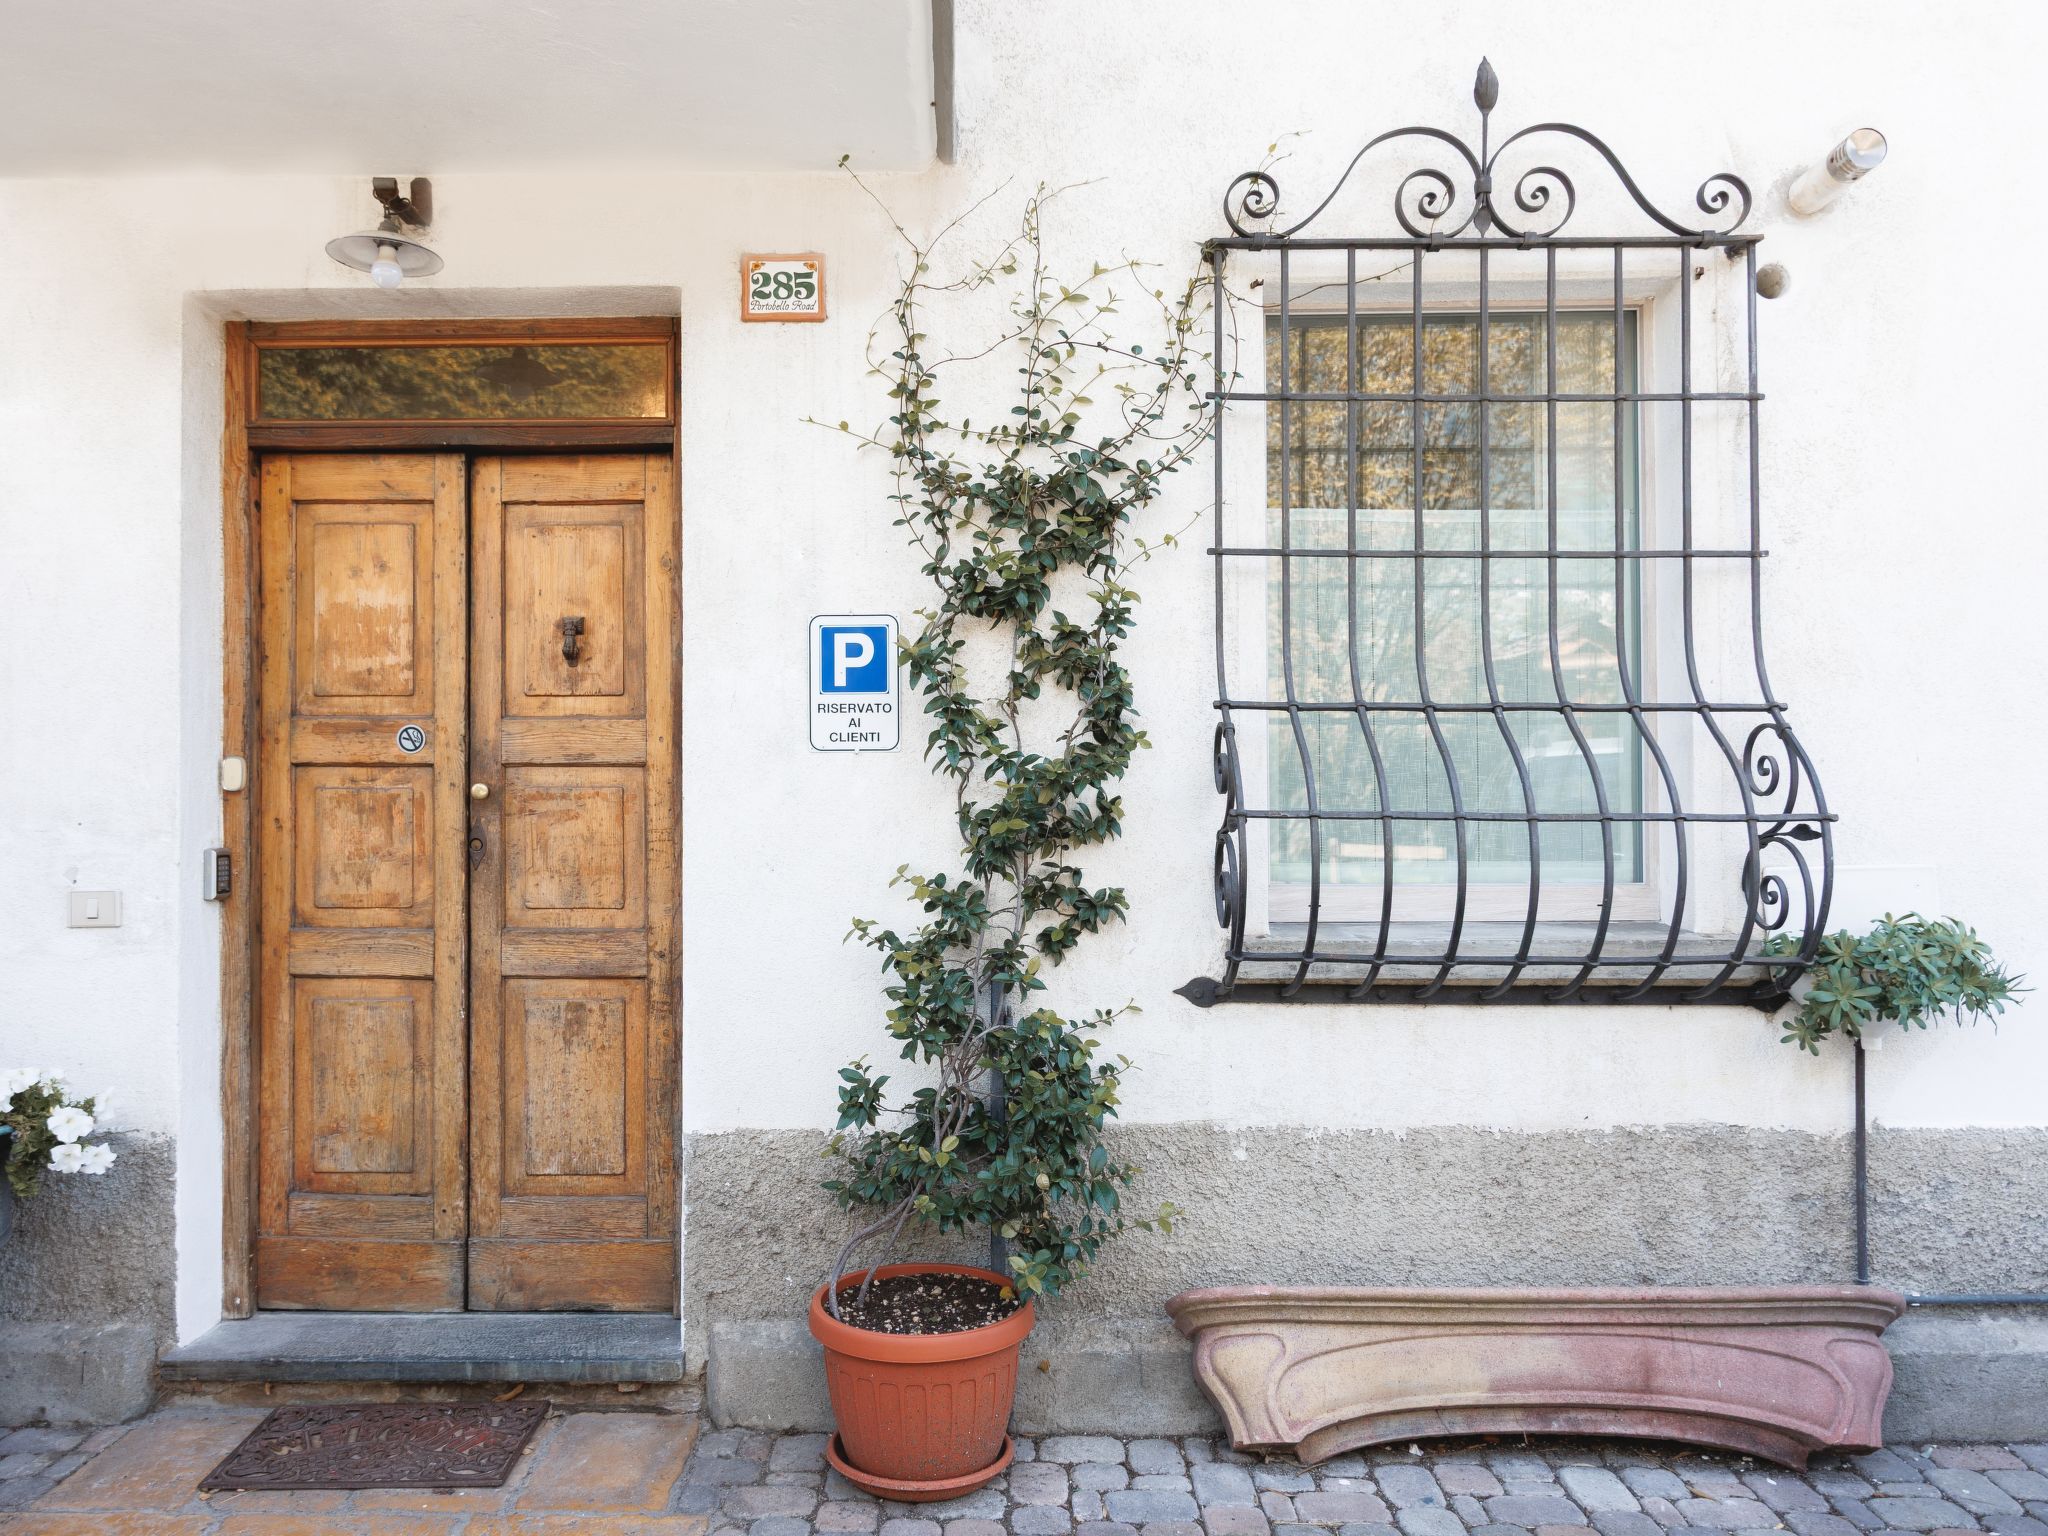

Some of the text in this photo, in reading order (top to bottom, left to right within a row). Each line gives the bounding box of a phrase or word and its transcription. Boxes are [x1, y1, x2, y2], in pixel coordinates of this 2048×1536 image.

[750, 271, 816, 300] 285
[750, 299, 817, 311] Portobello Road
[833, 632, 875, 687] P
[817, 703, 892, 714] RISERVATO
[848, 717, 861, 728] AI
[829, 732, 881, 743] CLIENTI
